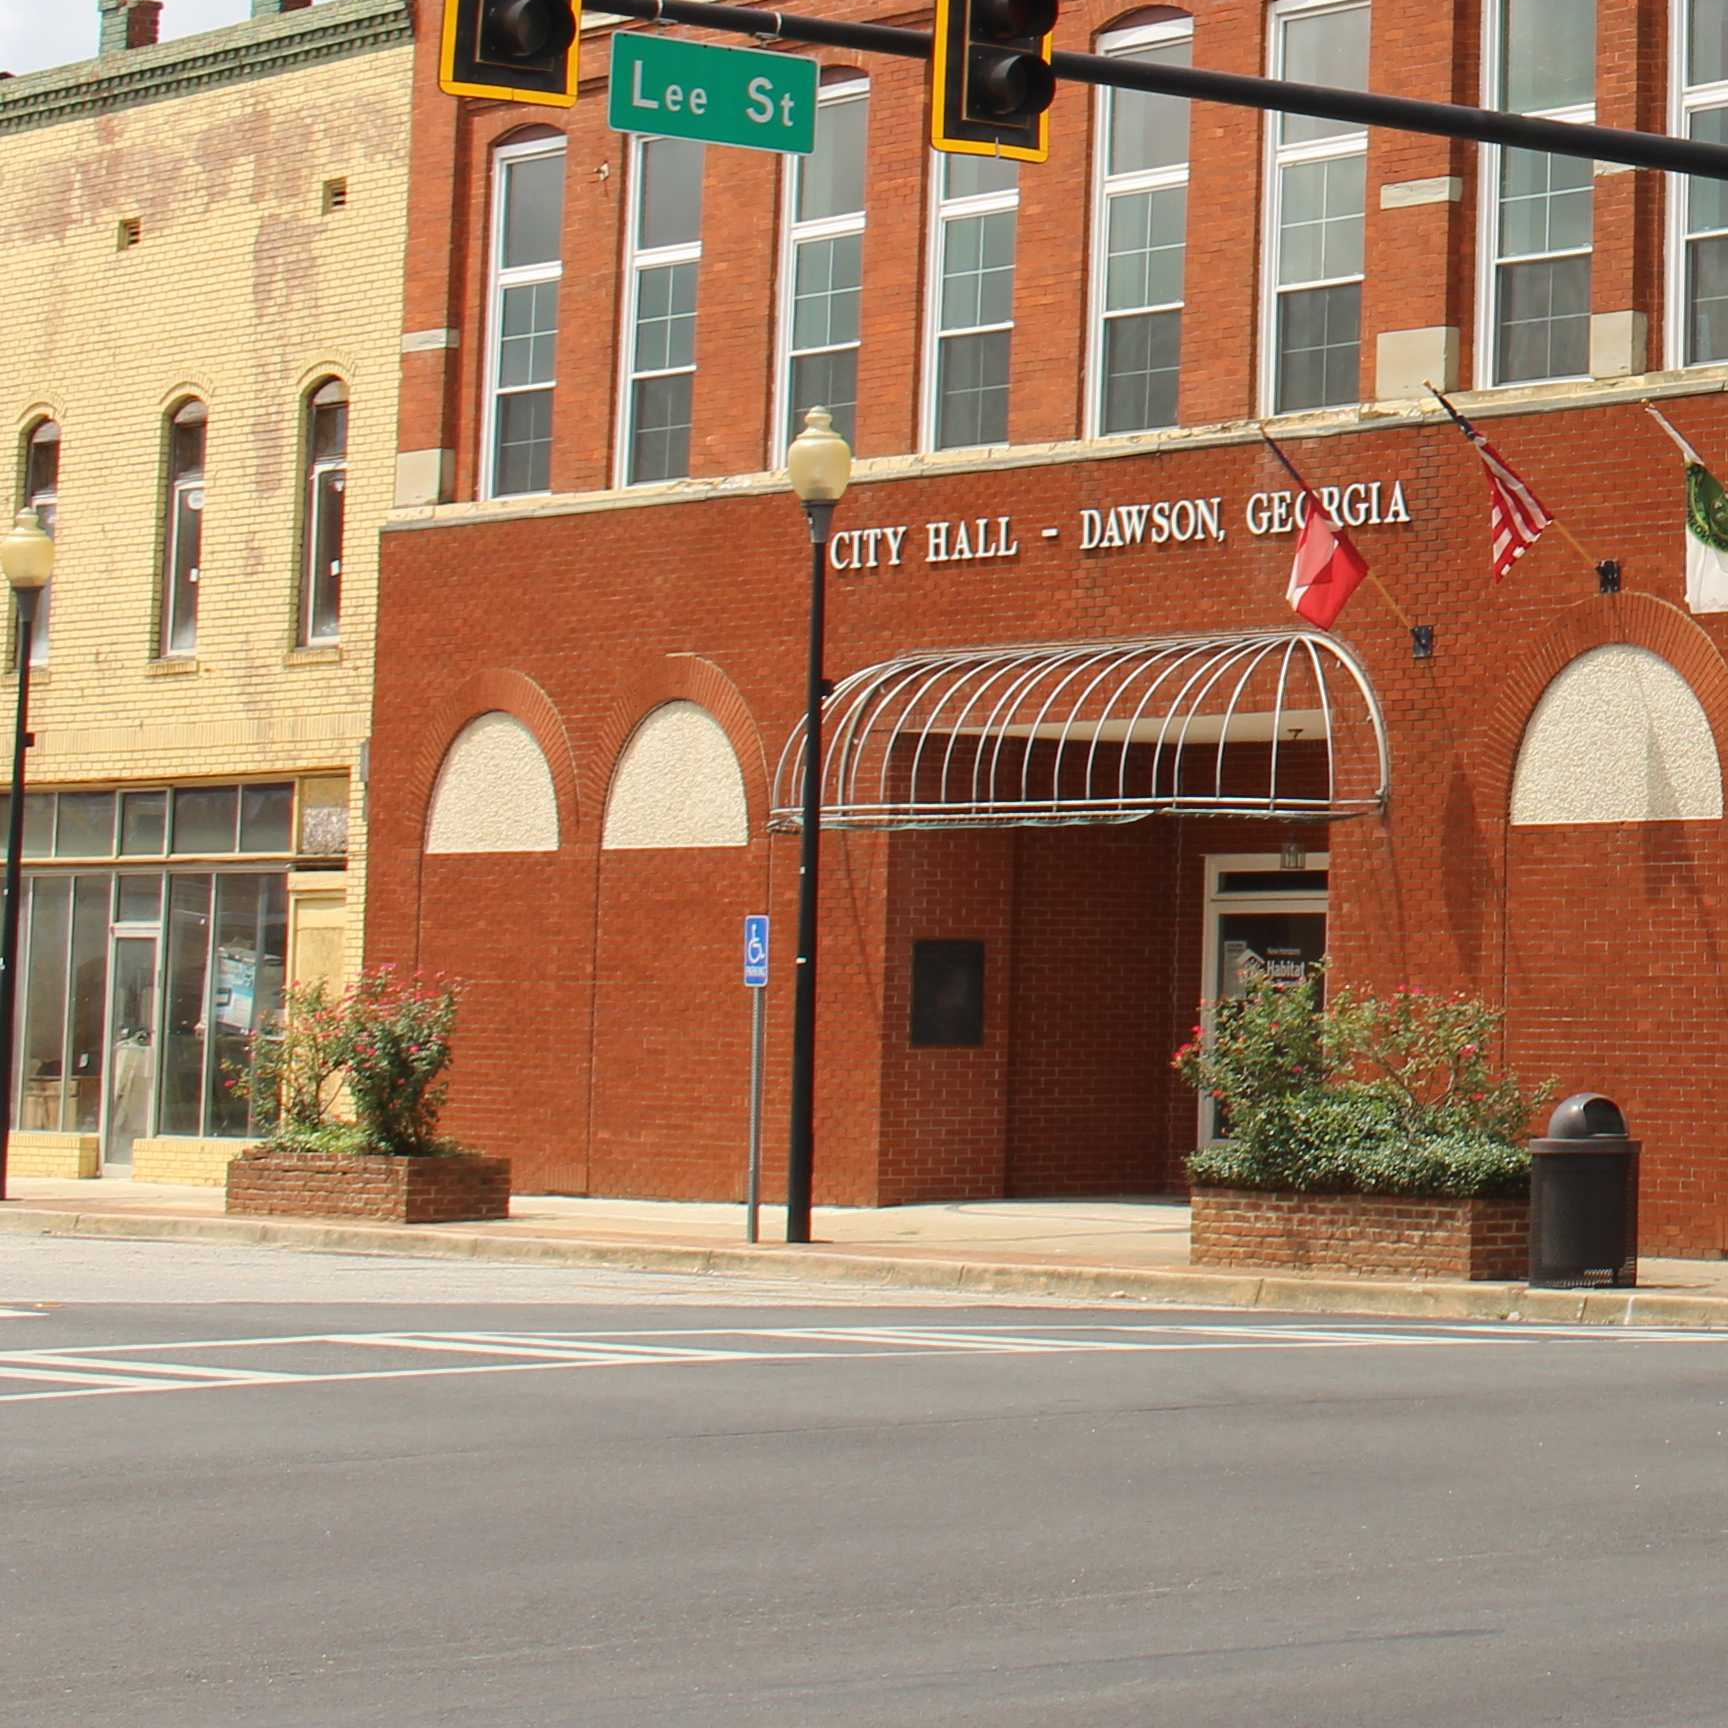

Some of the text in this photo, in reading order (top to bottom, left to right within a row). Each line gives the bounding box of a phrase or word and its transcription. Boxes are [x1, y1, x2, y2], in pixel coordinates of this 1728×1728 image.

[632, 60, 795, 127] Lee St
[830, 526, 907, 570] CITY
[925, 516, 1018, 562] HALL
[1079, 497, 1226, 550] DAWSON,
[1267, 959, 1305, 977] Habitat
